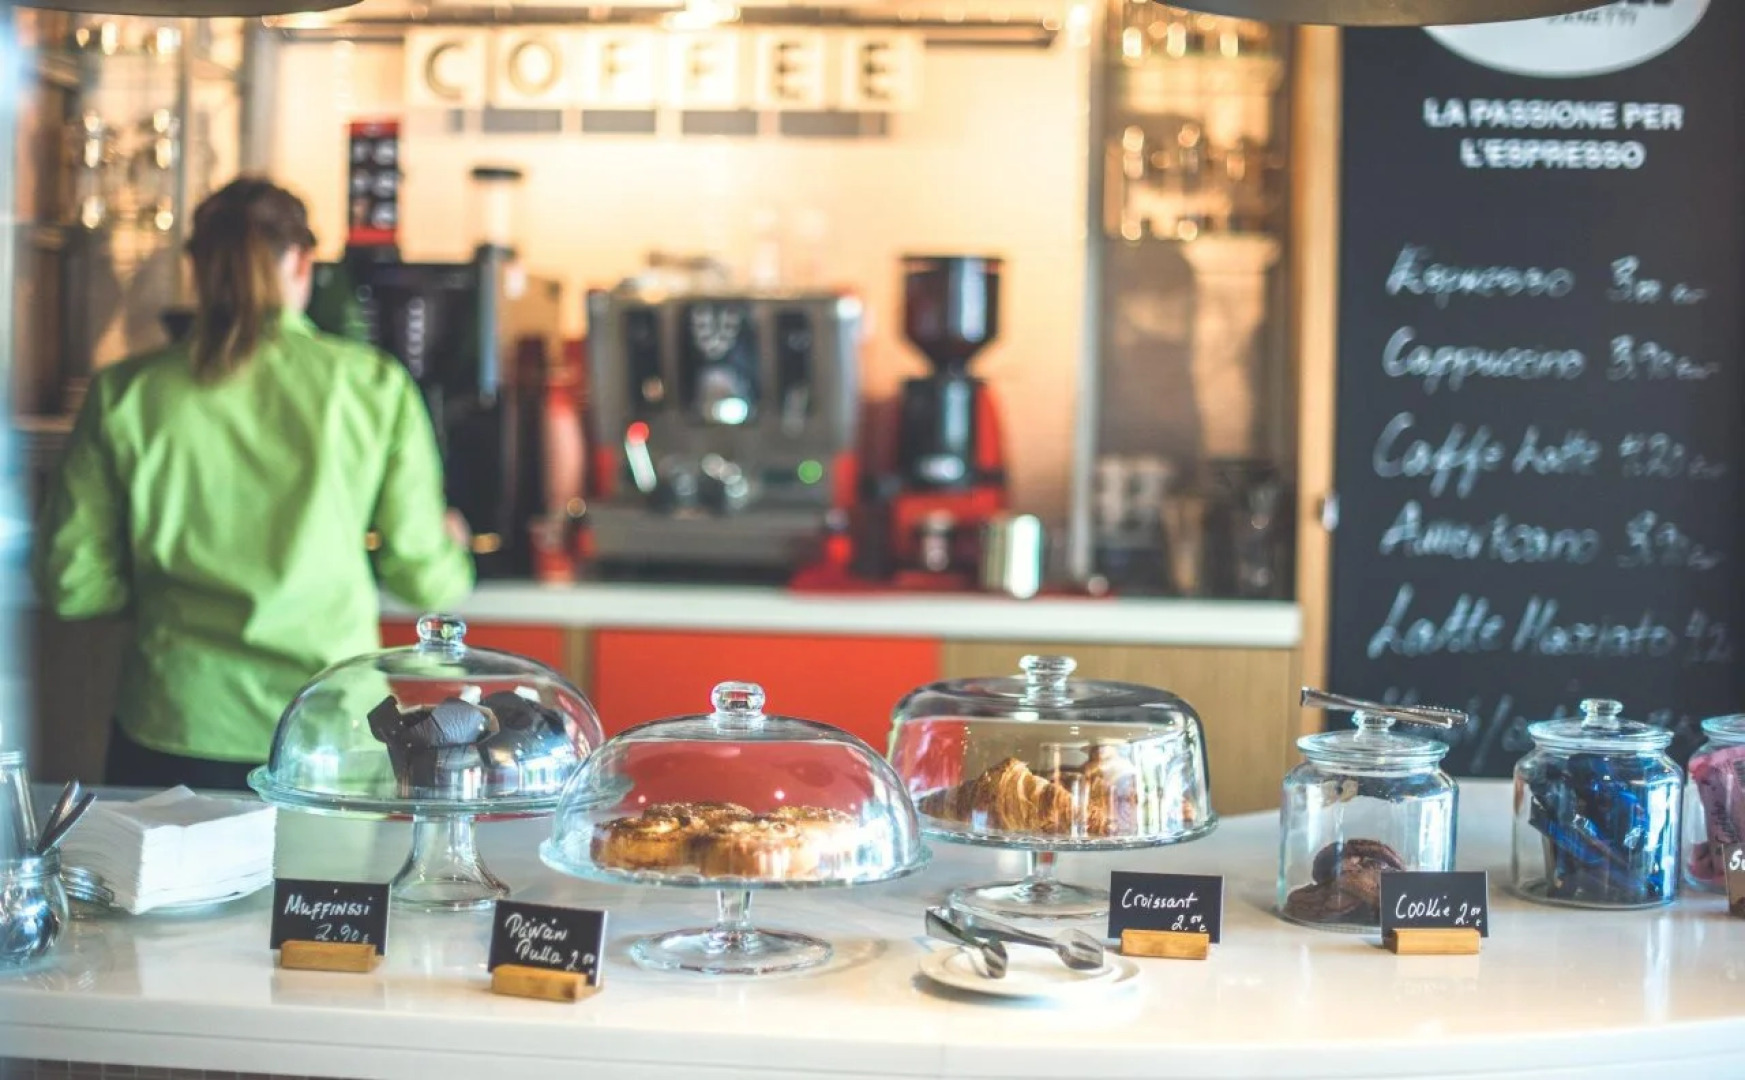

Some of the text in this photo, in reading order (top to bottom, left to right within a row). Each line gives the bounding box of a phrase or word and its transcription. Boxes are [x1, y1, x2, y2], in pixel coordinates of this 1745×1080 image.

[424, 37, 896, 99] COFFEE
[1423, 97, 1684, 131] LA PASSIONE PER
[1460, 138, 1646, 170] L'ESPRESSO
[1367, 582, 1506, 659] Latte
[1121, 888, 1199, 909] Croissant
[1395, 893, 1450, 919] Cookie
[515, 937, 562, 964] Pulla
